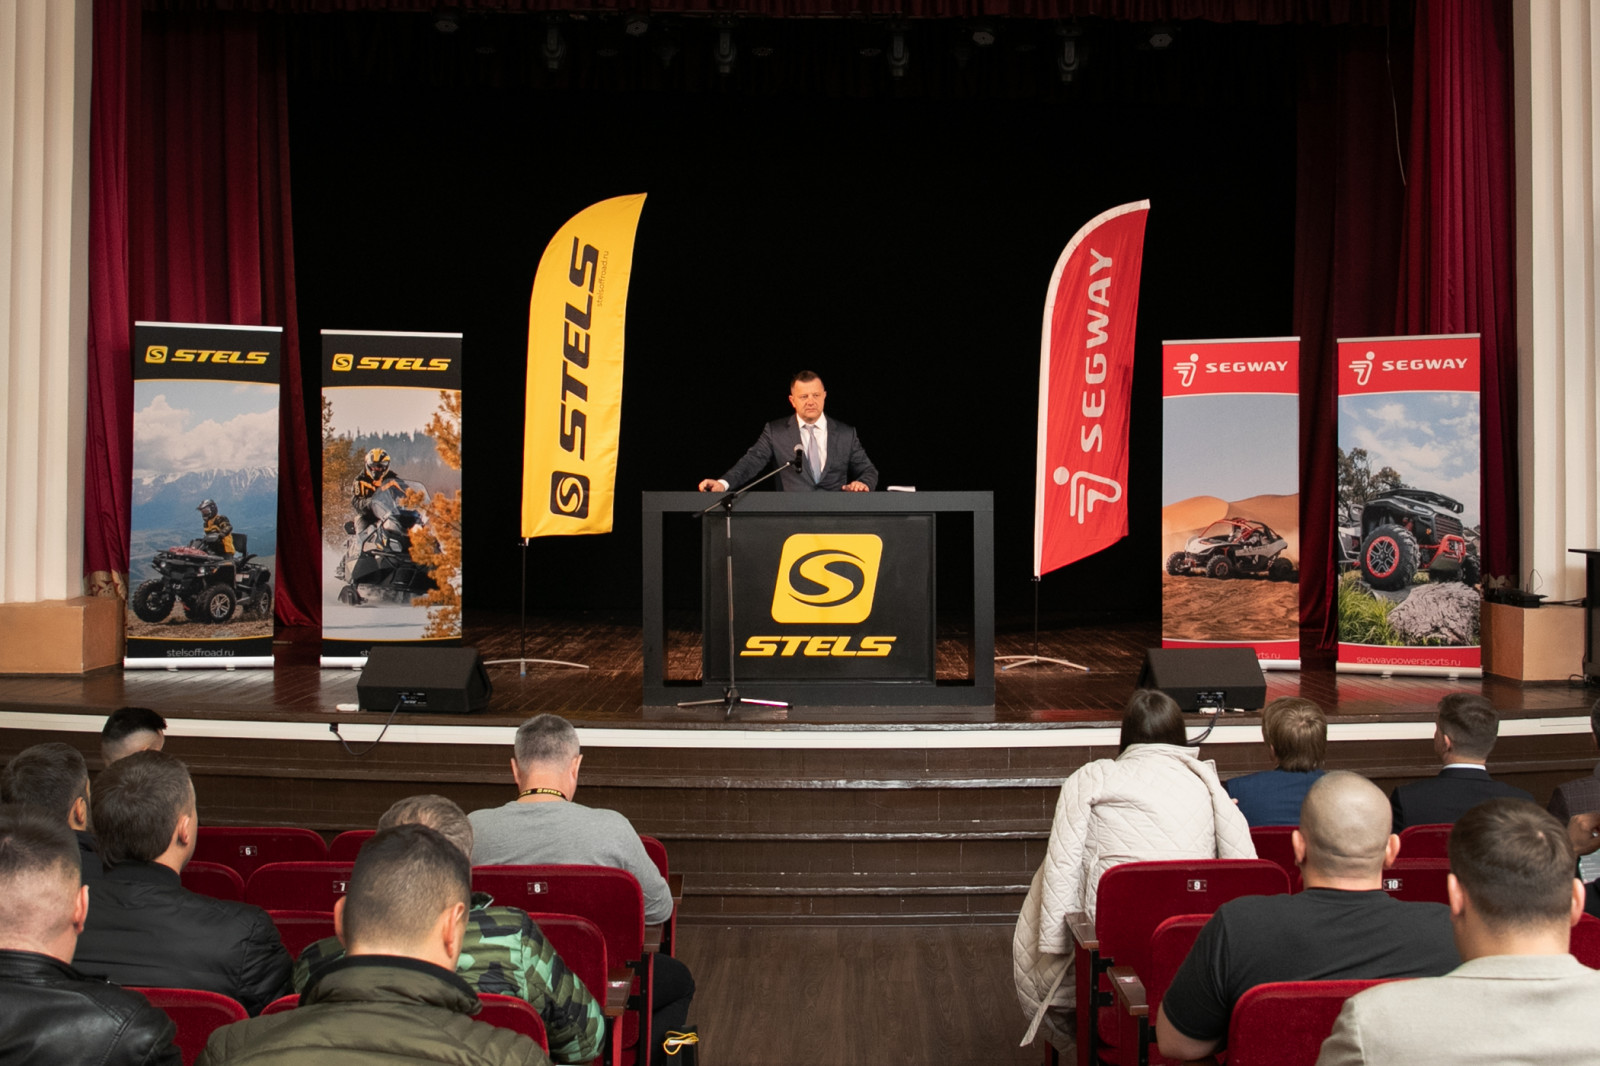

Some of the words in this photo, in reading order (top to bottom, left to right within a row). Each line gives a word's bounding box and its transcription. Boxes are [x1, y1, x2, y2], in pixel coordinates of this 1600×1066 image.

[559, 236, 599, 462] STELS
[1080, 247, 1113, 453] SEGWAY
[171, 349, 270, 364] STELS
[356, 357, 452, 371] STELS
[1205, 361, 1288, 373] SEGWAY
[1382, 358, 1468, 371] SEGWAY
[739, 635, 897, 657] STELS
[166, 648, 235, 657] stelsoffroad.ru
[245, 847, 251, 856] 6
[340, 882, 346, 892] 7
[534, 883, 541, 893] 8
[1194, 881, 1201, 890] 9
[1388, 880, 1398, 889] 10
